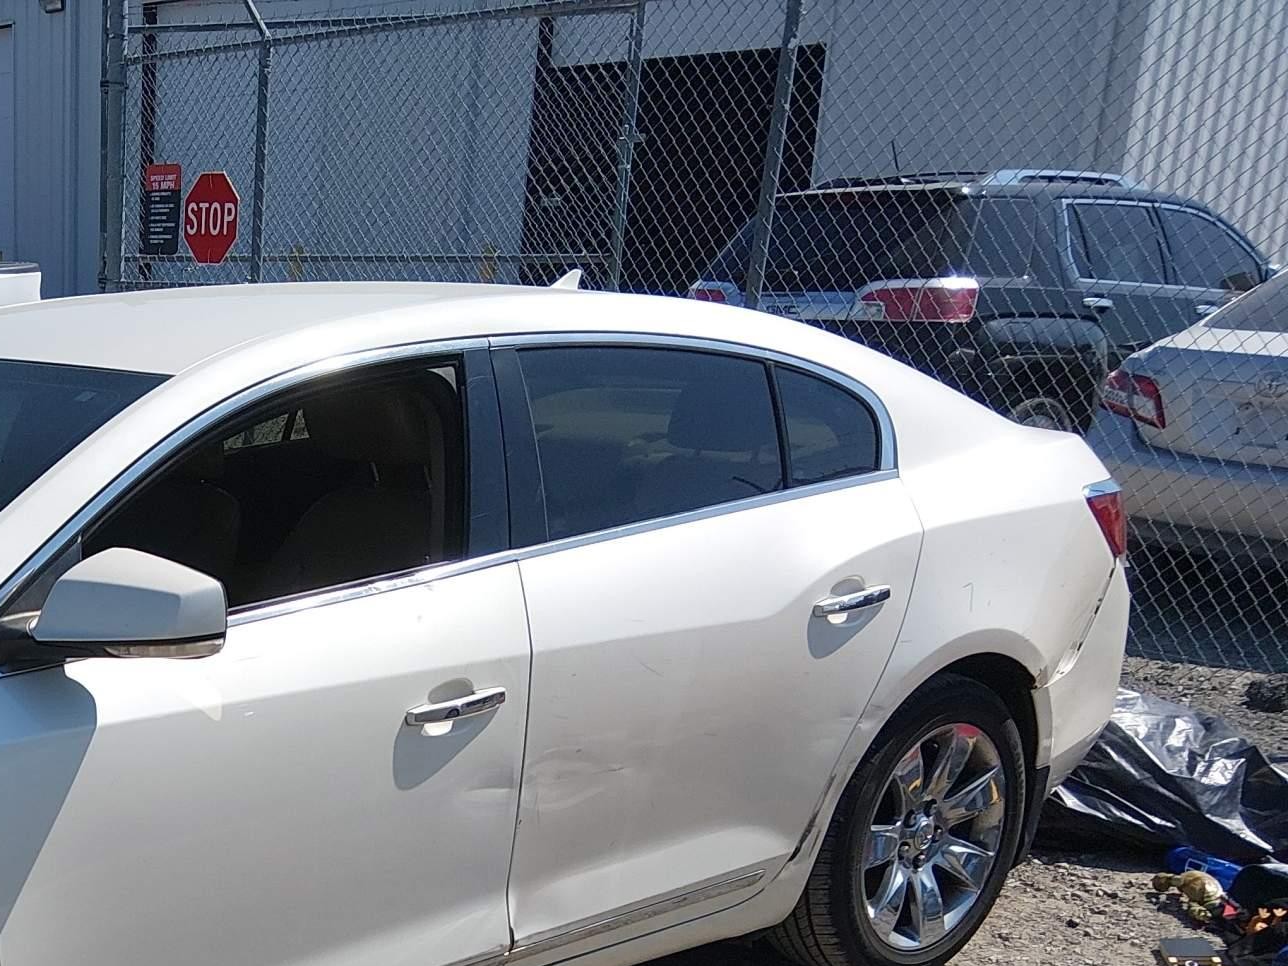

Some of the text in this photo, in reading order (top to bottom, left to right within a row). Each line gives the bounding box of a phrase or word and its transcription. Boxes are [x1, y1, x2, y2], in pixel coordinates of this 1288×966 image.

[152, 181, 175, 190] 15 MPH
[186, 202, 235, 236] STOP
